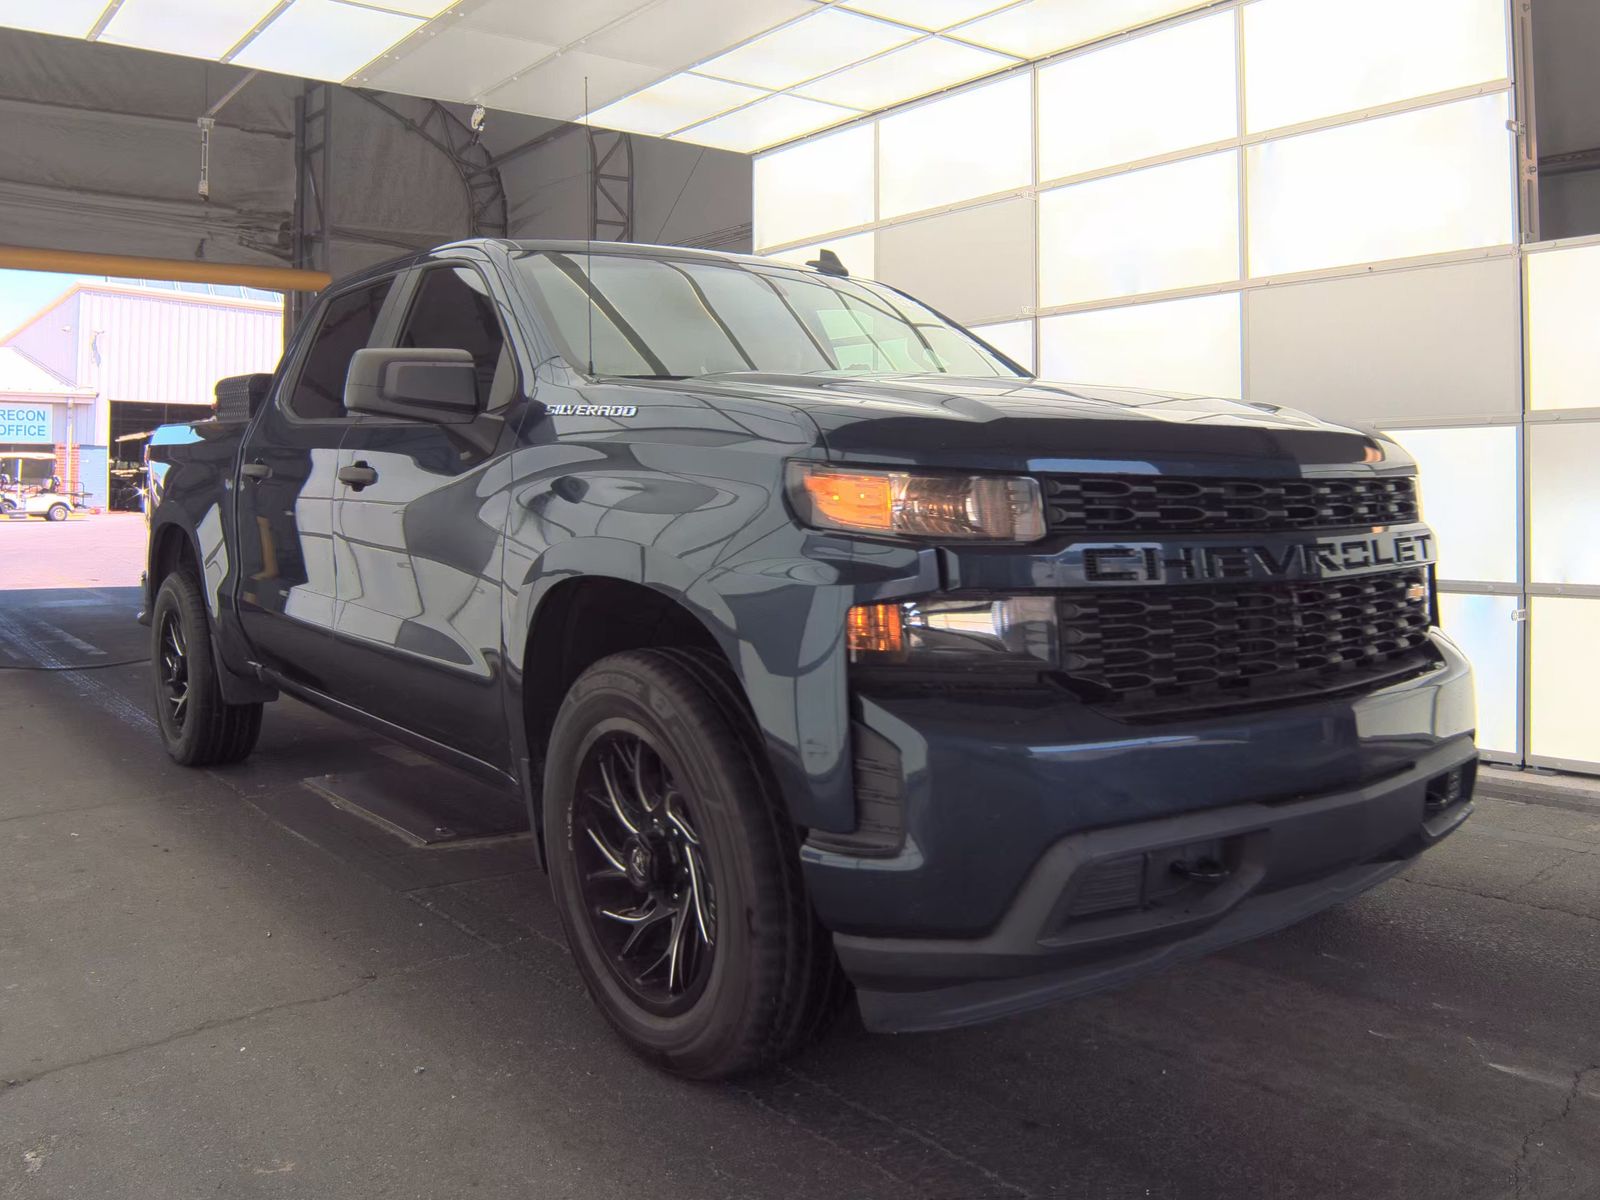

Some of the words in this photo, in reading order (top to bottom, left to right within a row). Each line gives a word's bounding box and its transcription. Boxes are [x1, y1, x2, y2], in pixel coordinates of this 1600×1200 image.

[0, 410, 46, 421] RECON
[545, 405, 637, 417] SILVERADO
[0, 425, 46, 436] OFFICE
[1084, 533, 1431, 582] CHEVROLET
